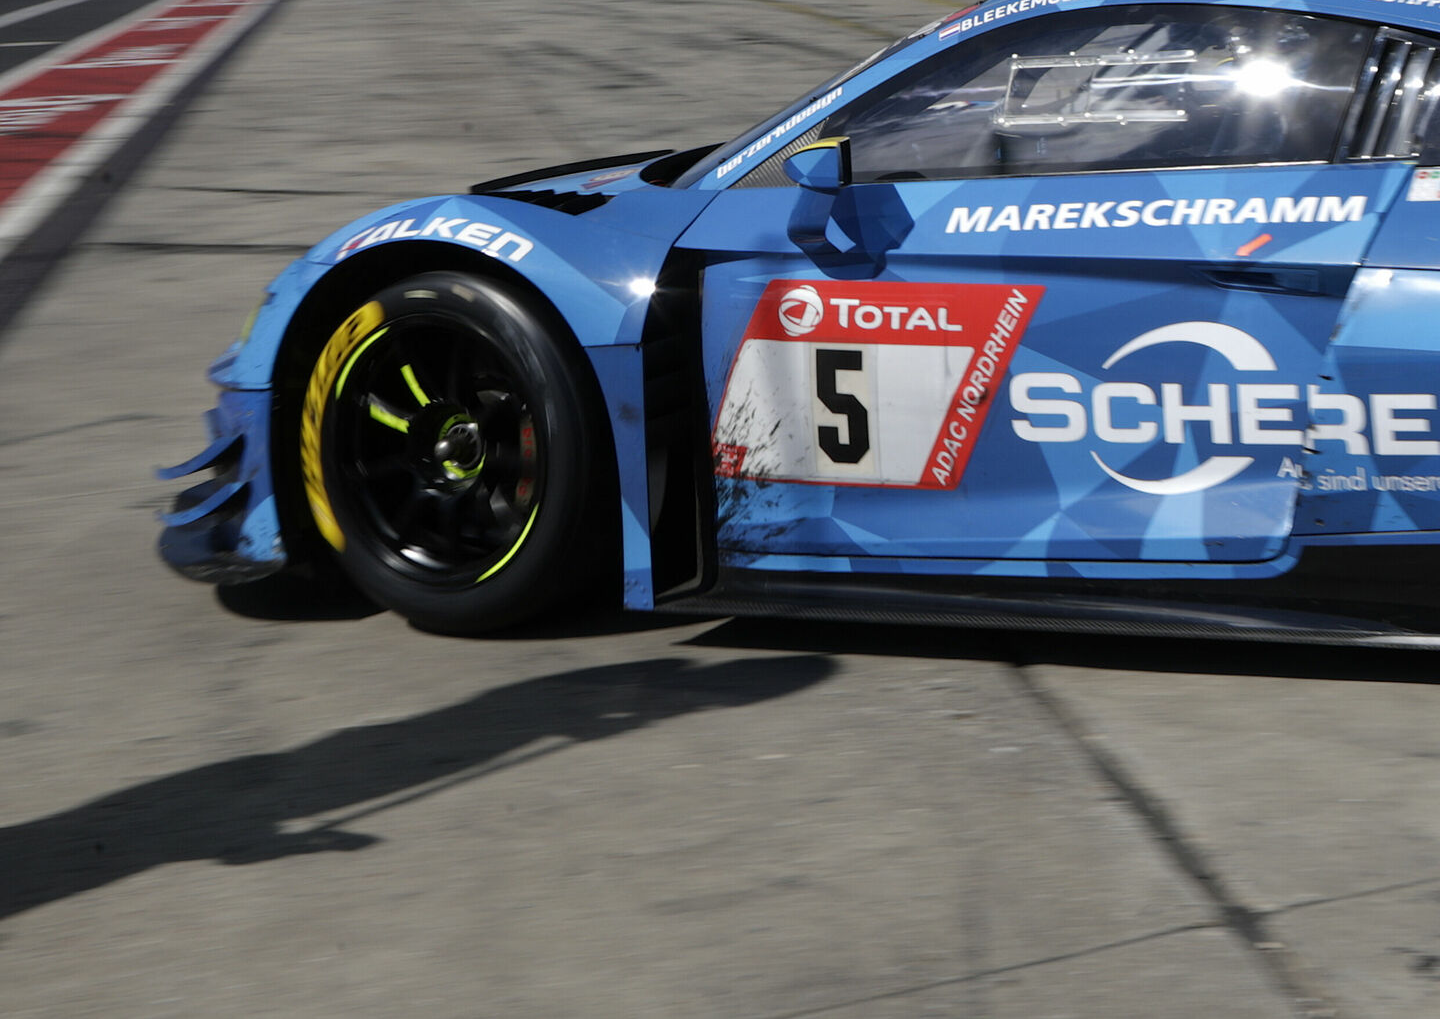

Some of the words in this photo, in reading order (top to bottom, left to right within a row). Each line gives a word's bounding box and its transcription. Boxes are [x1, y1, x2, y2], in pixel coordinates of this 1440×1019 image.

[945, 196, 1368, 233] MAREKSCHRAMM
[335, 216, 534, 263] FALKEN
[816, 348, 870, 464] 5
[930, 418, 969, 486] ADAC
[962, 288, 1029, 422] NORDRHEIN
[1317, 467, 1368, 492] sind
